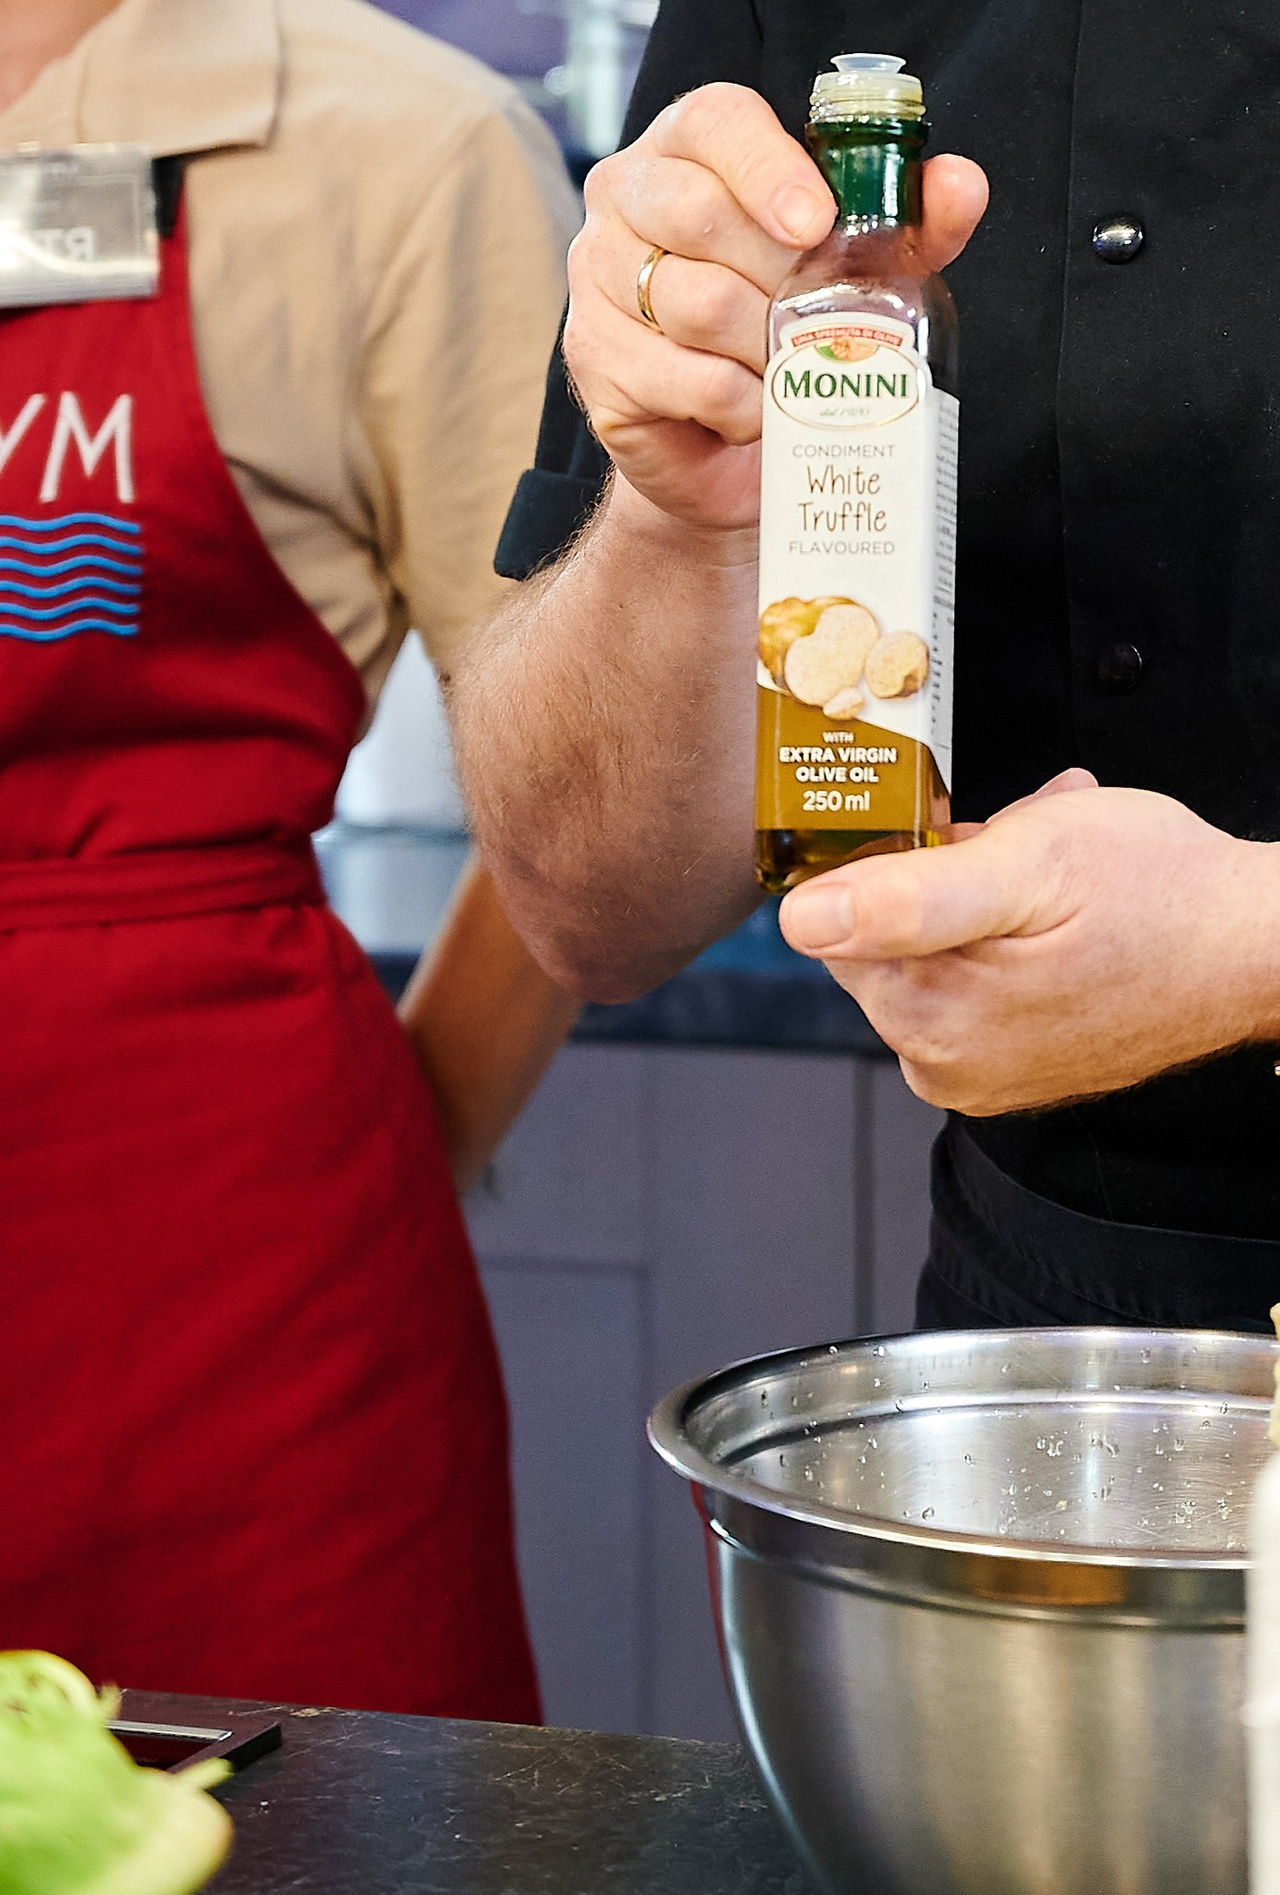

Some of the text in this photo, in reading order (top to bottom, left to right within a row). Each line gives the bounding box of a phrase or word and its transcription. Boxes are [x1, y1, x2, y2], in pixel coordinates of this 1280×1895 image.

[783, 370, 908, 399] MONINI
[792, 445, 896, 457] CONDIMENT
[806, 464, 881, 495] White
[798, 500, 887, 532] Truffle
[789, 541, 895, 555] FLAVOURED
[822, 731, 855, 744] WITH
[779, 746, 898, 764] EXTRA VIRGIN
[795, 766, 880, 783] OLIVE OIL
[802, 790, 871, 812] 250 ml
